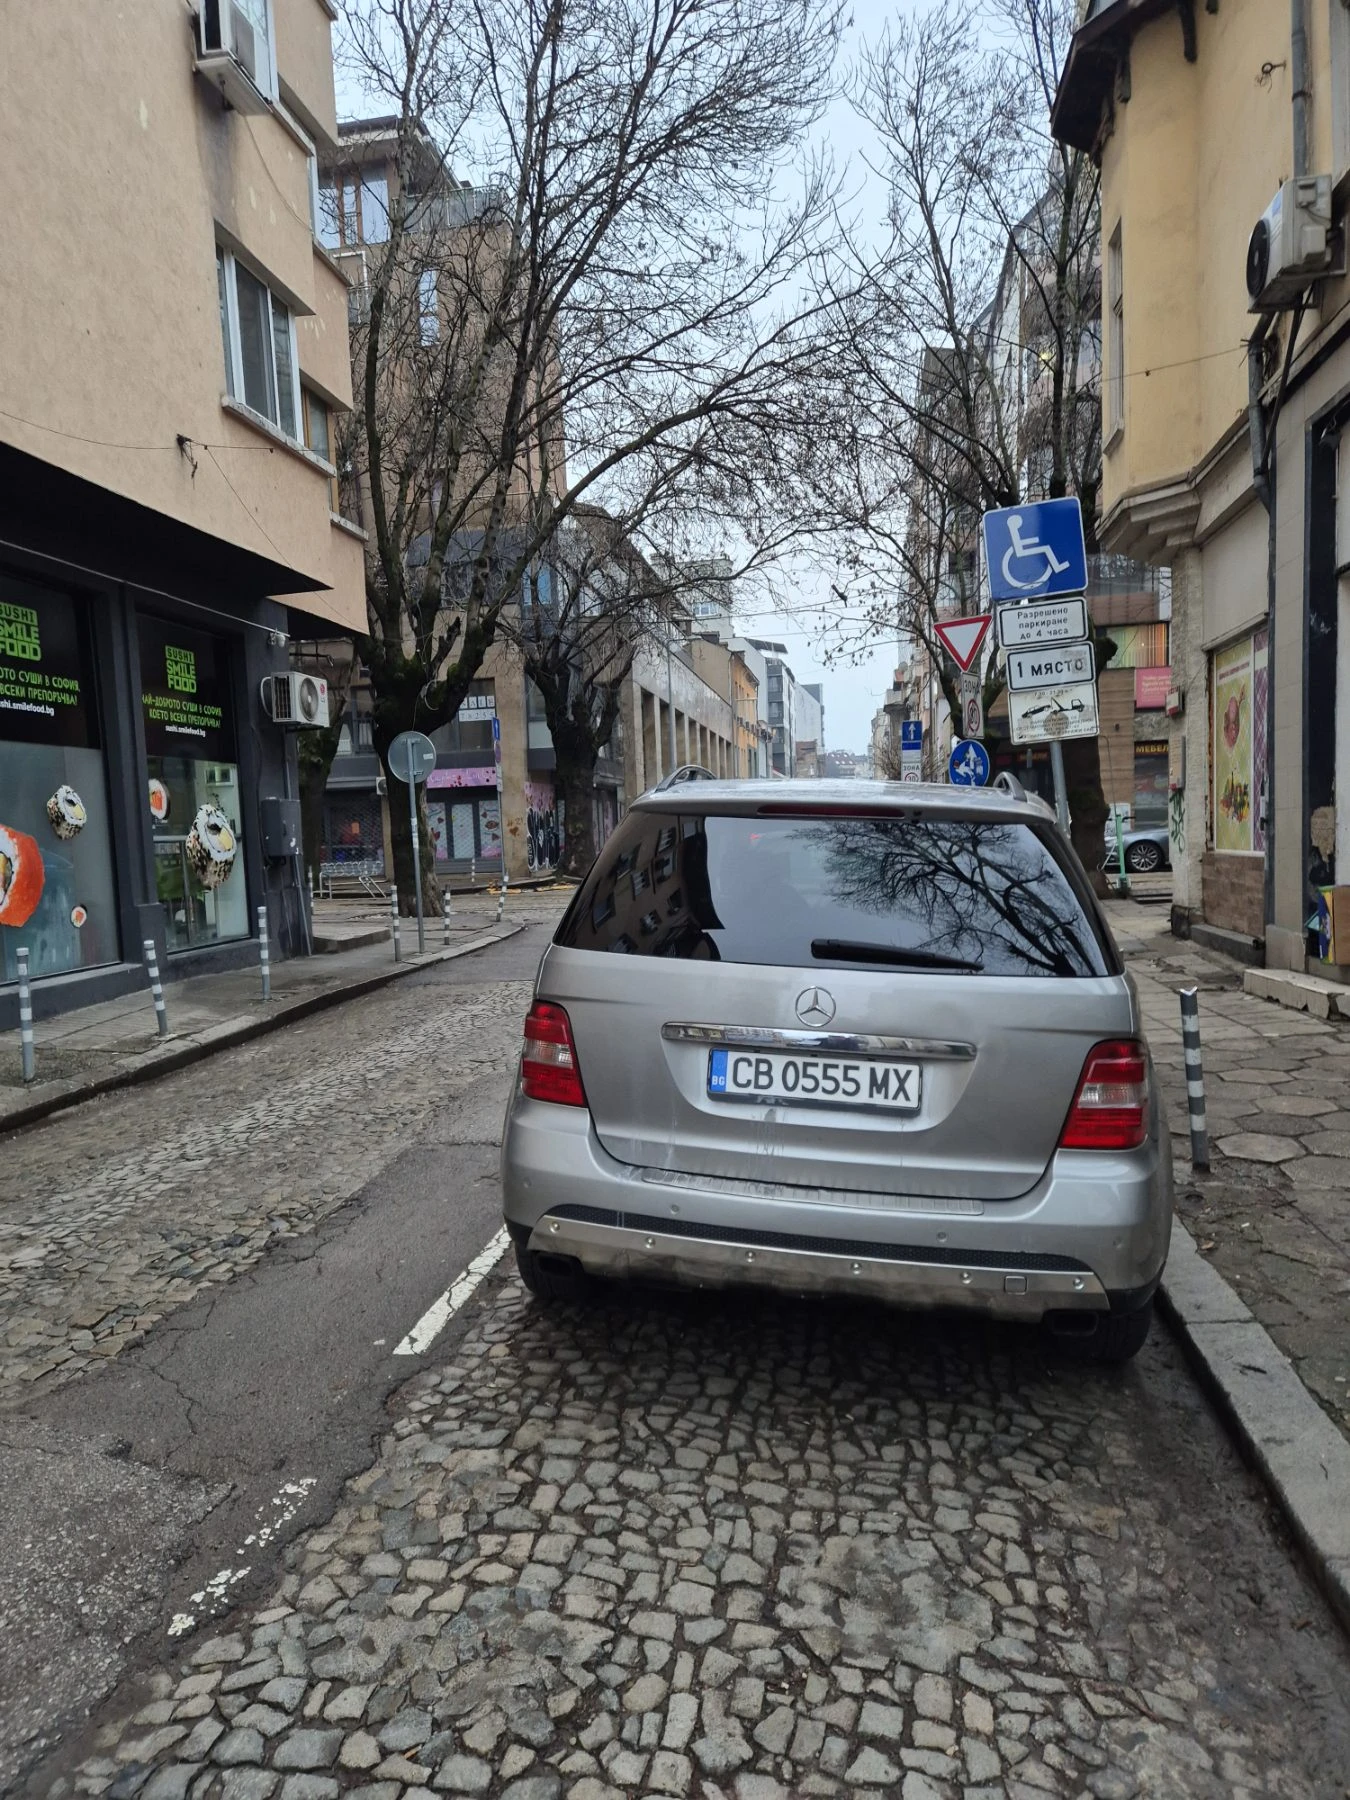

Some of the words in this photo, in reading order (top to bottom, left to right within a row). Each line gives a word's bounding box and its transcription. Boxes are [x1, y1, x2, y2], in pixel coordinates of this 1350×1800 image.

[1017, 607, 1069, 620] Разрешено
[1018, 618, 1068, 629] паркиране
[1047, 628, 1069, 636] часа
[166, 647, 194, 663] SUSHI
[166, 660, 196, 680] SMILE
[1017, 661, 1023, 678] 1
[18, 670, 43, 685] СУШИ
[45, 675, 50, 687] В
[168, 674, 197, 693] FOOD
[28, 687, 78, 705] ПРЕПОРЪЧВА!
[0, 699, 55, 717] shi.smilefood.bg
[182, 701, 198, 712] СУШИ
[149, 708, 169, 720] КОЕТО
[169, 711, 187, 723] ВСЕКИ
[165, 725, 206, 738] sushi.smilefood.bg
[711, 1075, 725, 1086] BG
[732, 1057, 774, 1090] CB
[781, 1060, 861, 1097] 0555
[868, 1067, 913, 1102] MX
